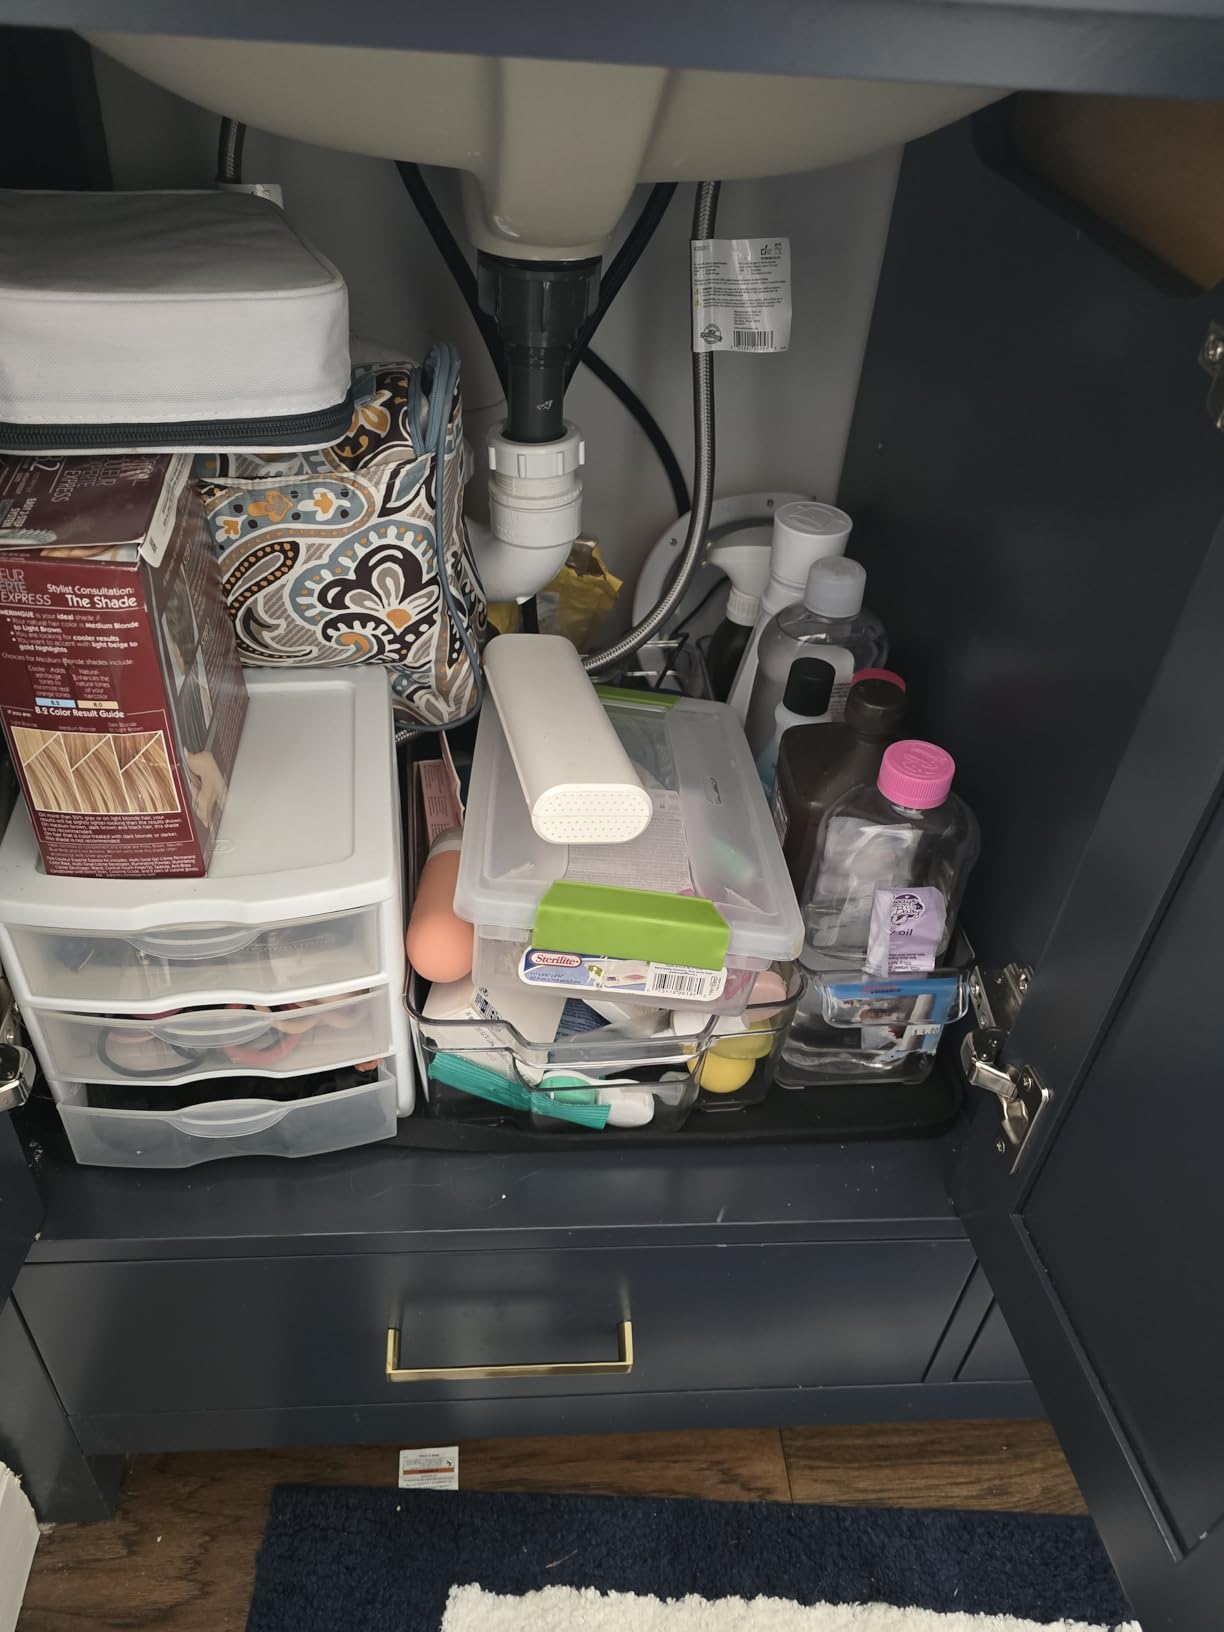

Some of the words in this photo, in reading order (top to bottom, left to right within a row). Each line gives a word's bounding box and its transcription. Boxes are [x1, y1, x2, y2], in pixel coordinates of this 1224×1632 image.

[51, 470, 81, 503] EXPRESS
[47, 584, 73, 594] Stylist
[75, 586, 135, 596] Consultation:
[1, 592, 51, 605] EXPRESS
[65, 594, 91, 608] The
[94, 596, 137, 609] Shade
[35, 706, 48, 714] 8.2
[49, 708, 71, 716] Color
[73, 709, 98, 717] Result
[99, 710, 124, 718] Guide
[535, 953, 576, 966] Sterilite
